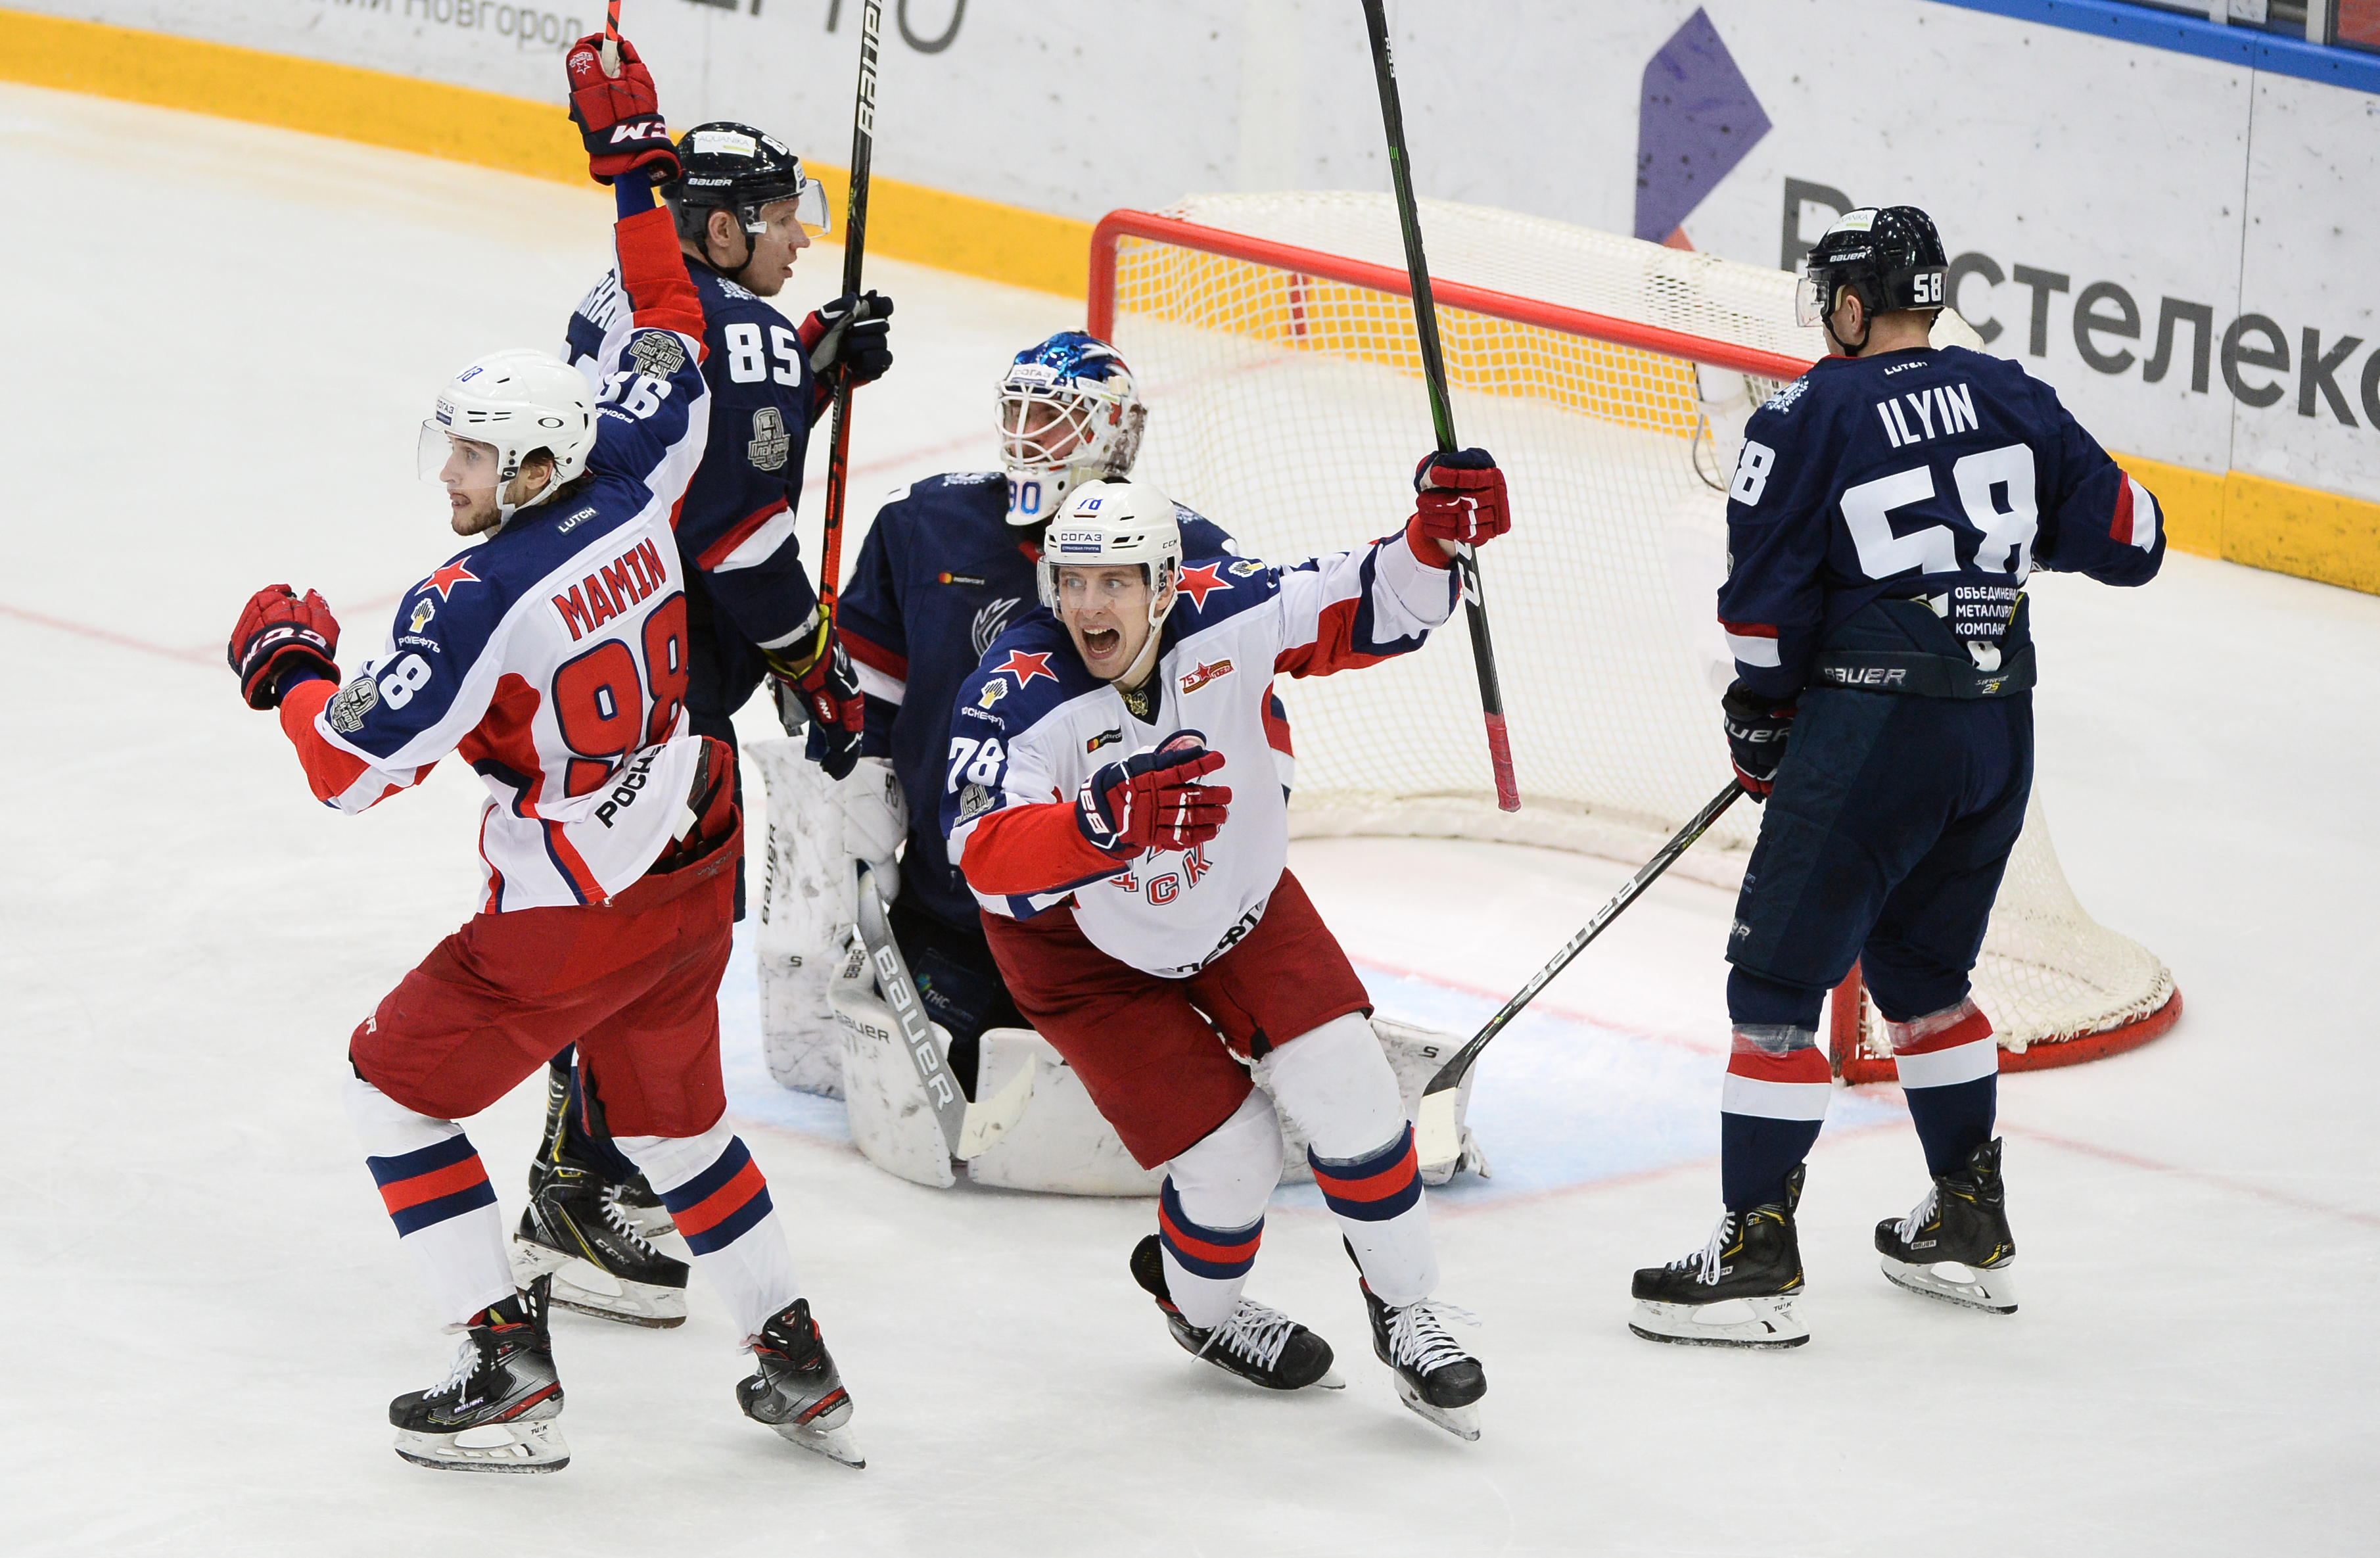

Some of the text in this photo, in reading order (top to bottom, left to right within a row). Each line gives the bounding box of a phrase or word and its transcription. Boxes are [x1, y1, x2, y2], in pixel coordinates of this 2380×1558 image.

[857, 0, 882, 132] BAUE
[698, 133, 749, 147] AQUANIKA
[688, 177, 733, 187] BAUER
[1829, 251, 1867, 262] BAUER
[1780, 176, 2380, 432] Рстелек
[1913, 273, 1942, 303] 58
[725, 323, 801, 387] 85
[595, 407, 635, 424] РОСНЕ
[1877, 383, 1978, 448] ILYIN
[1730, 437, 1775, 507] 8
[558, 506, 596, 534] LUTCH
[1840, 443, 2038, 584] 58
[1061, 533, 1102, 542] СОГАЗ
[1162, 539, 1178, 549] CCM
[551, 537, 668, 642] MAMIN
[1179, 673, 1196, 689] 75
[1824, 667, 1907, 687] BAUER
[551, 590, 689, 799] 98
[948, 737, 1006, 793] 78
[762, 823, 777, 926] BAUER
[1526, 876, 1639, 994] BAUER
[835, 1010, 891, 1044] BAUER
[874, 945, 955, 1111] BAUER
[1913, 1239, 1935, 1249] BAUER
[454, 1396, 484, 1414] BAUER
